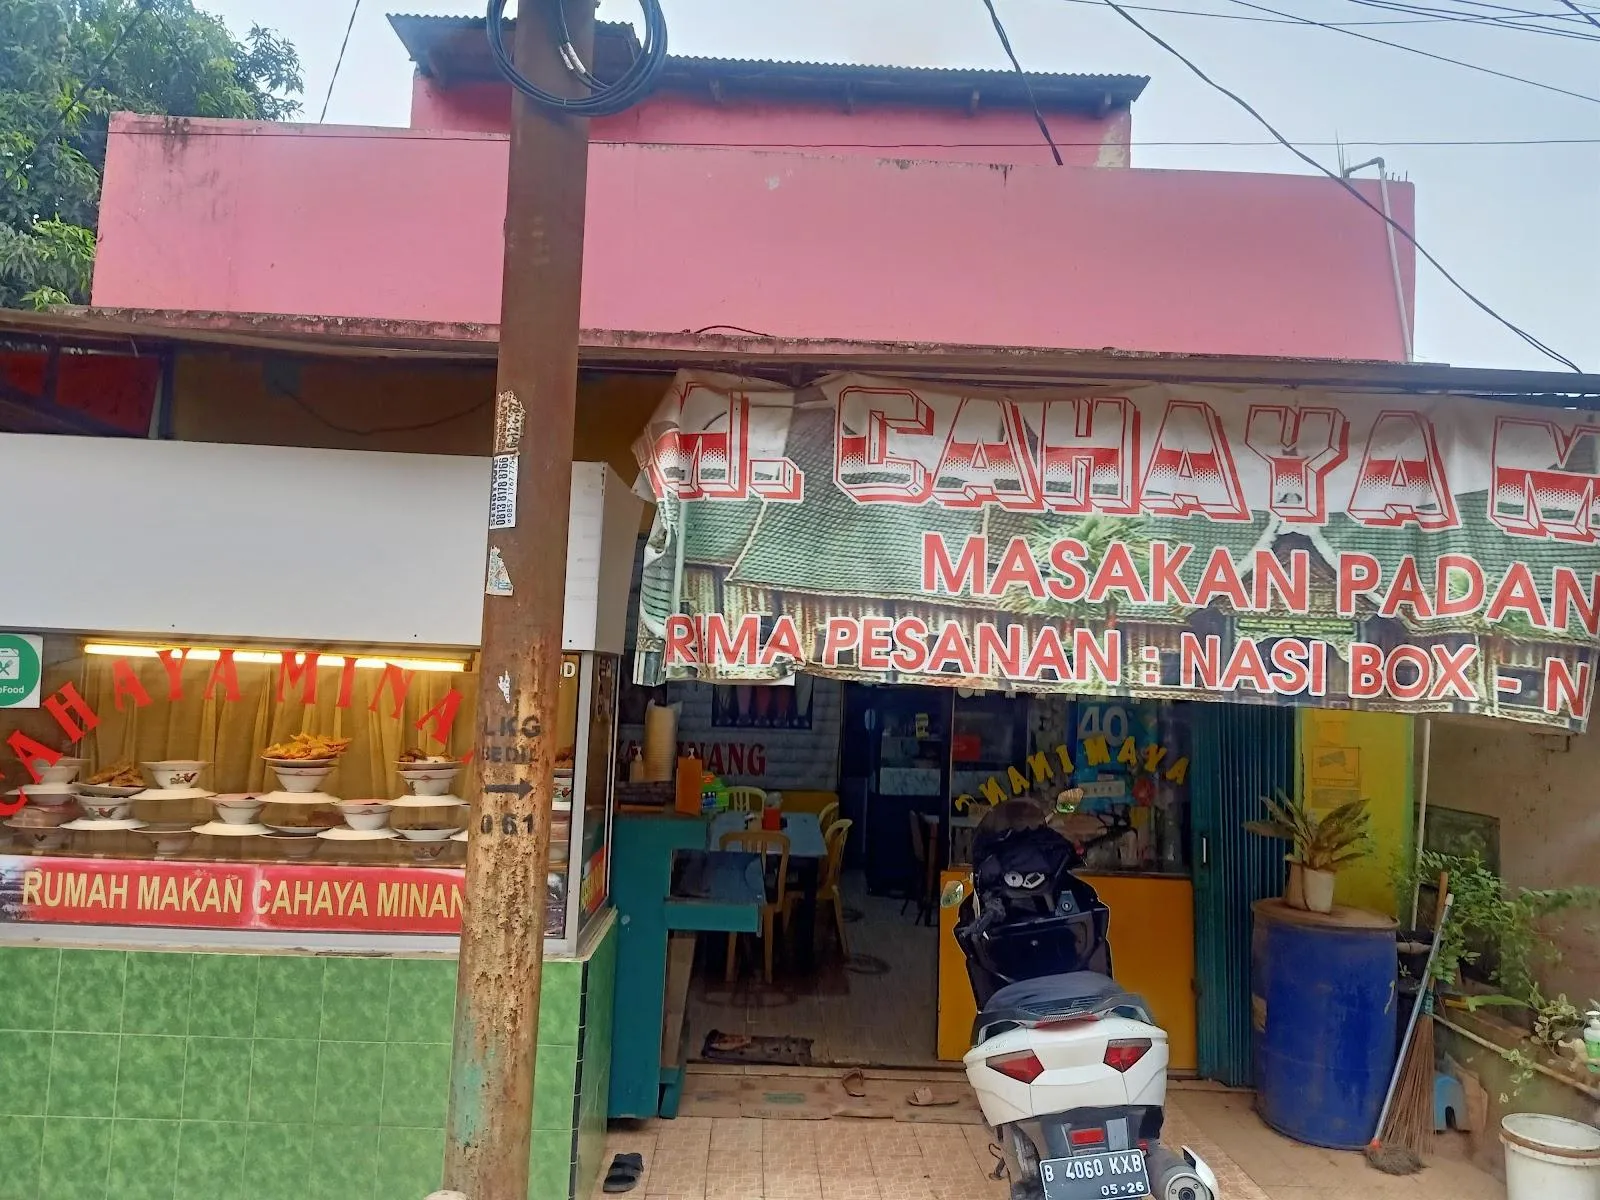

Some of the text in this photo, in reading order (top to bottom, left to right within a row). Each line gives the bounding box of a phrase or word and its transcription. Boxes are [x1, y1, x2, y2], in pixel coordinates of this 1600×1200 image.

[496, 457, 509, 525] 0813 8178 8766
[833, 386, 1462, 531] CAHAYA
[921, 531, 1600, 638] MASAKAN PADAN
[0, 685, 25, 694] Food
[821, 615, 1121, 684] PESANAN
[1180, 632, 1327, 697] NASI
[1348, 643, 1481, 701] BOX
[276, 648, 475, 765] MINA
[22, 868, 129, 911] RUMAH
[137, 874, 243, 914] MAKAN
[252, 879, 369, 918] CAHAYA
[1043, 1155, 1142, 1183] B 4060 KXB
